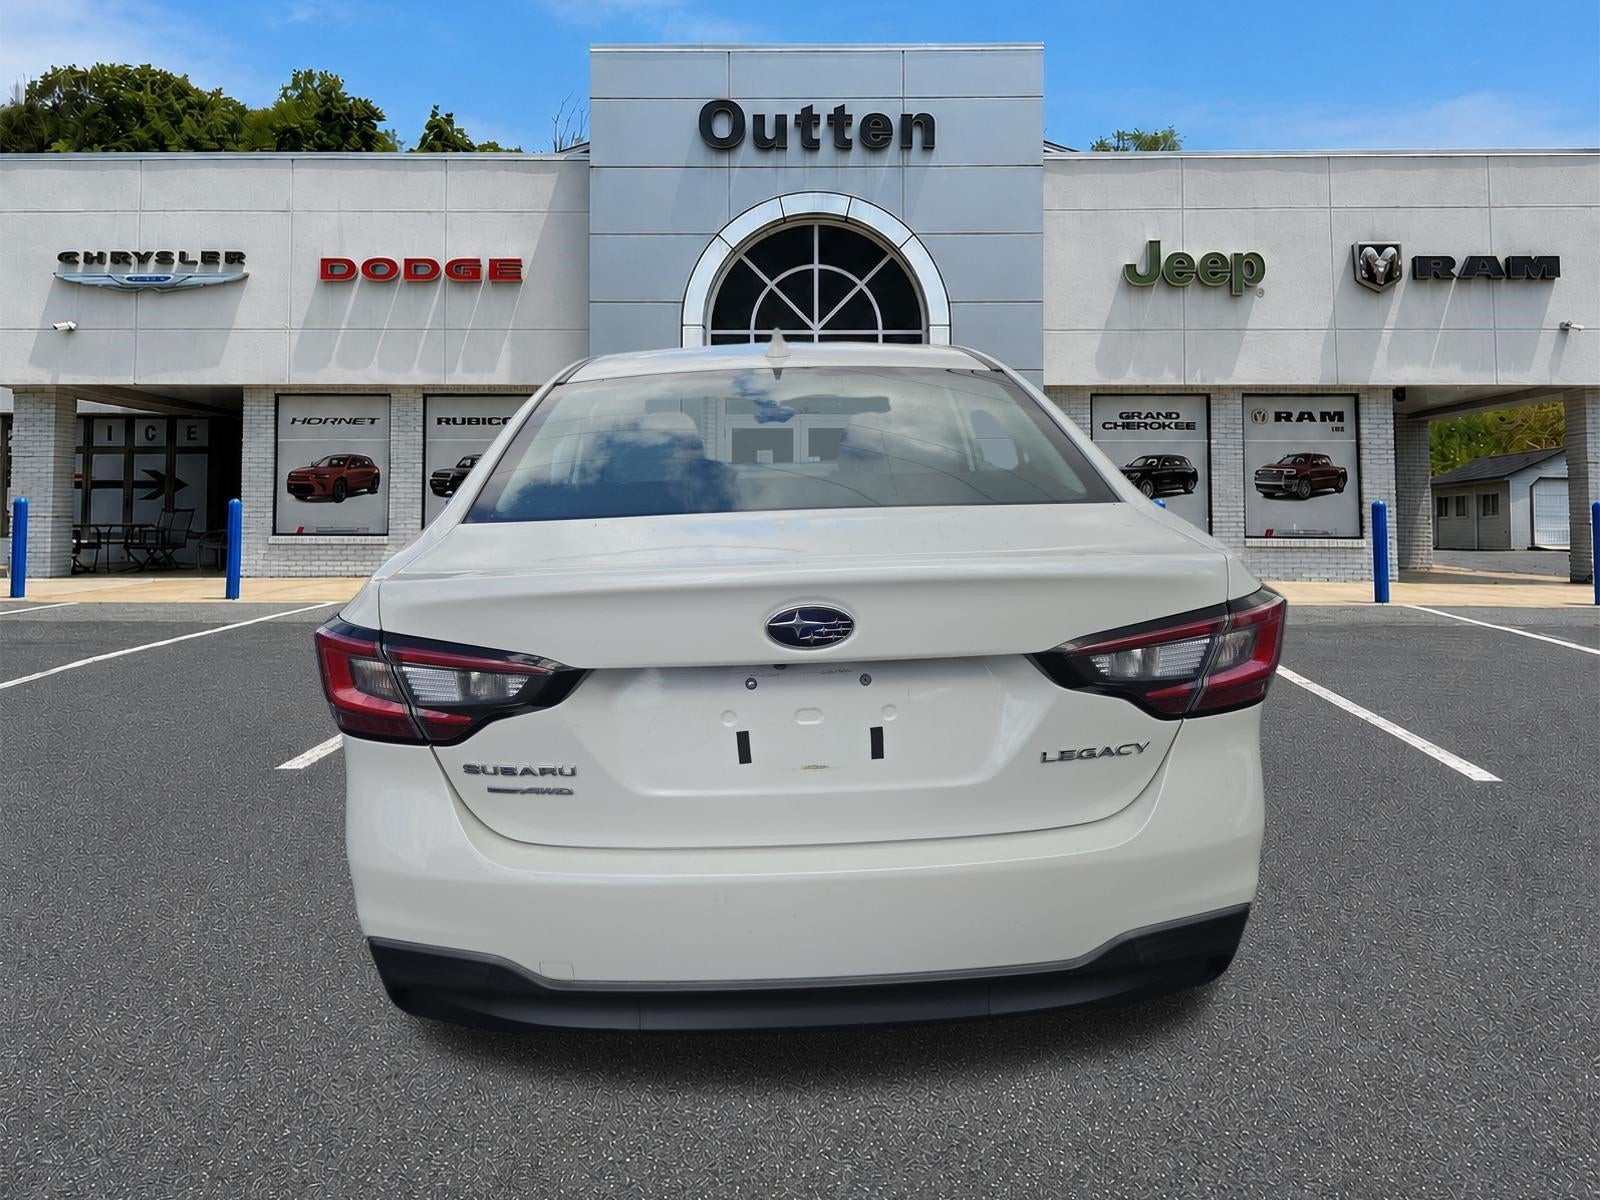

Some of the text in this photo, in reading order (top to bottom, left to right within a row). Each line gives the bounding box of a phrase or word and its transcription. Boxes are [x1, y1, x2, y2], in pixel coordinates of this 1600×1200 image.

[698, 99, 936, 150] Outten
[57, 251, 247, 266] CHRYSLER
[320, 257, 523, 283] DODGE
[1123, 240, 1266, 296] Jeep
[1411, 255, 1560, 280] RAM
[290, 417, 381, 426] HORNET
[1118, 411, 1181, 420] GRAND
[1274, 411, 1345, 423] RAM
[1101, 421, 1197, 431] CHEROKEE
[1040, 741, 1151, 764] LEGACY
[462, 764, 577, 777] SUBARU
[519, 787, 574, 796] AWD
